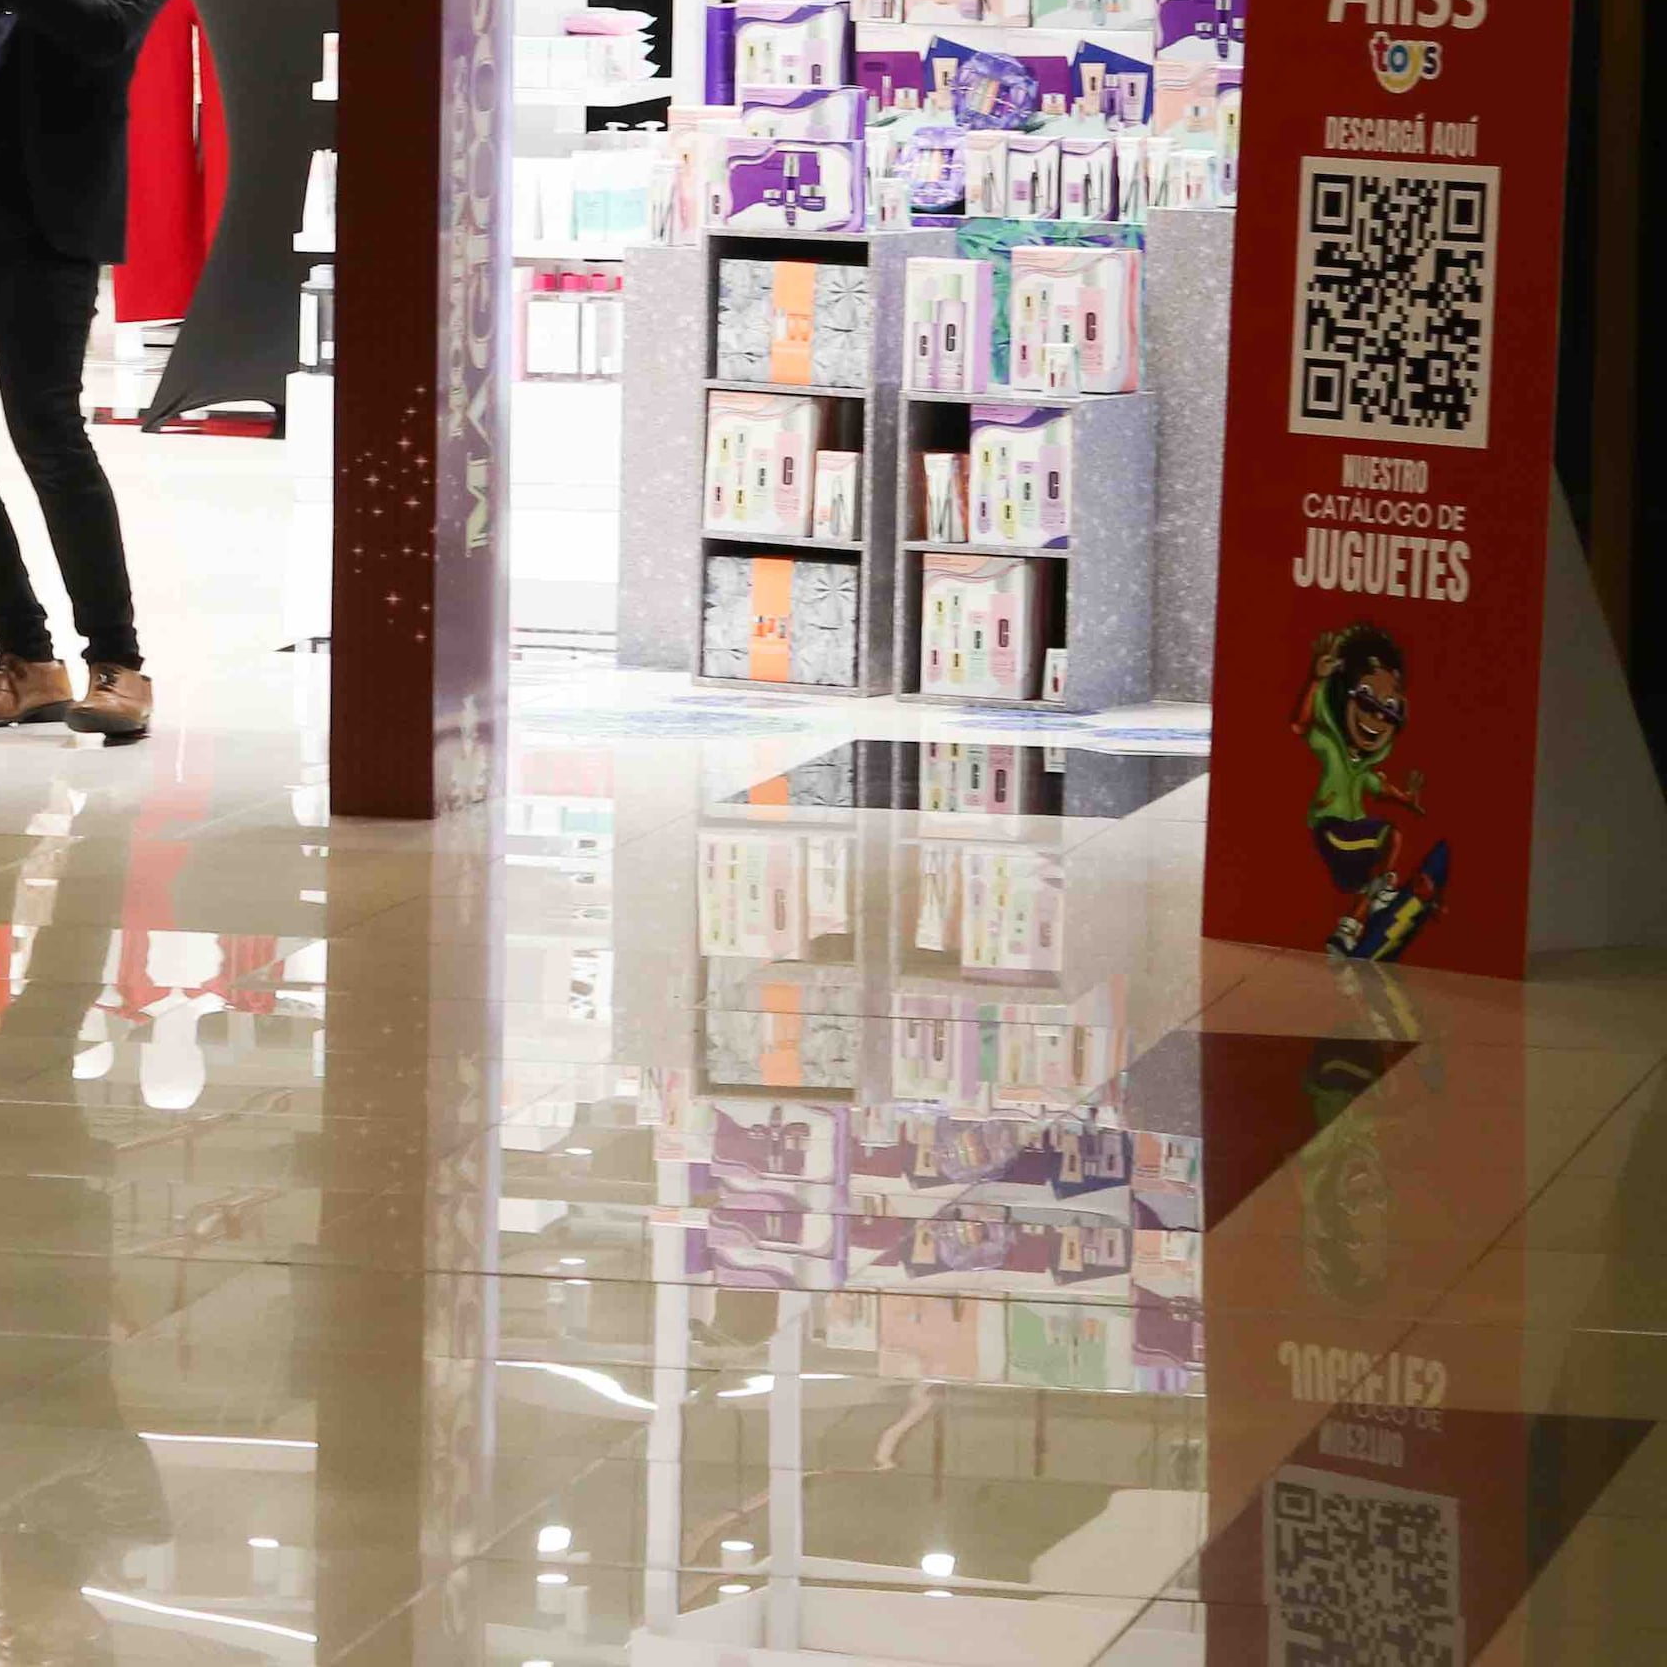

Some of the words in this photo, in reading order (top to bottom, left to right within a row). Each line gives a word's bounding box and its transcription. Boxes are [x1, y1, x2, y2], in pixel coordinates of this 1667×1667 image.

[1369, 31, 1443, 94] toys
[1323, 112, 1427, 155] DESCARGÁ
[1430, 115, 1480, 158] AQUÍ
[1342, 453, 1429, 494] NUESTRO
[1302, 491, 1433, 528] CATÁLOGO
[1437, 504, 1467, 531] DE
[1292, 526, 1471, 603] JUGUETES
